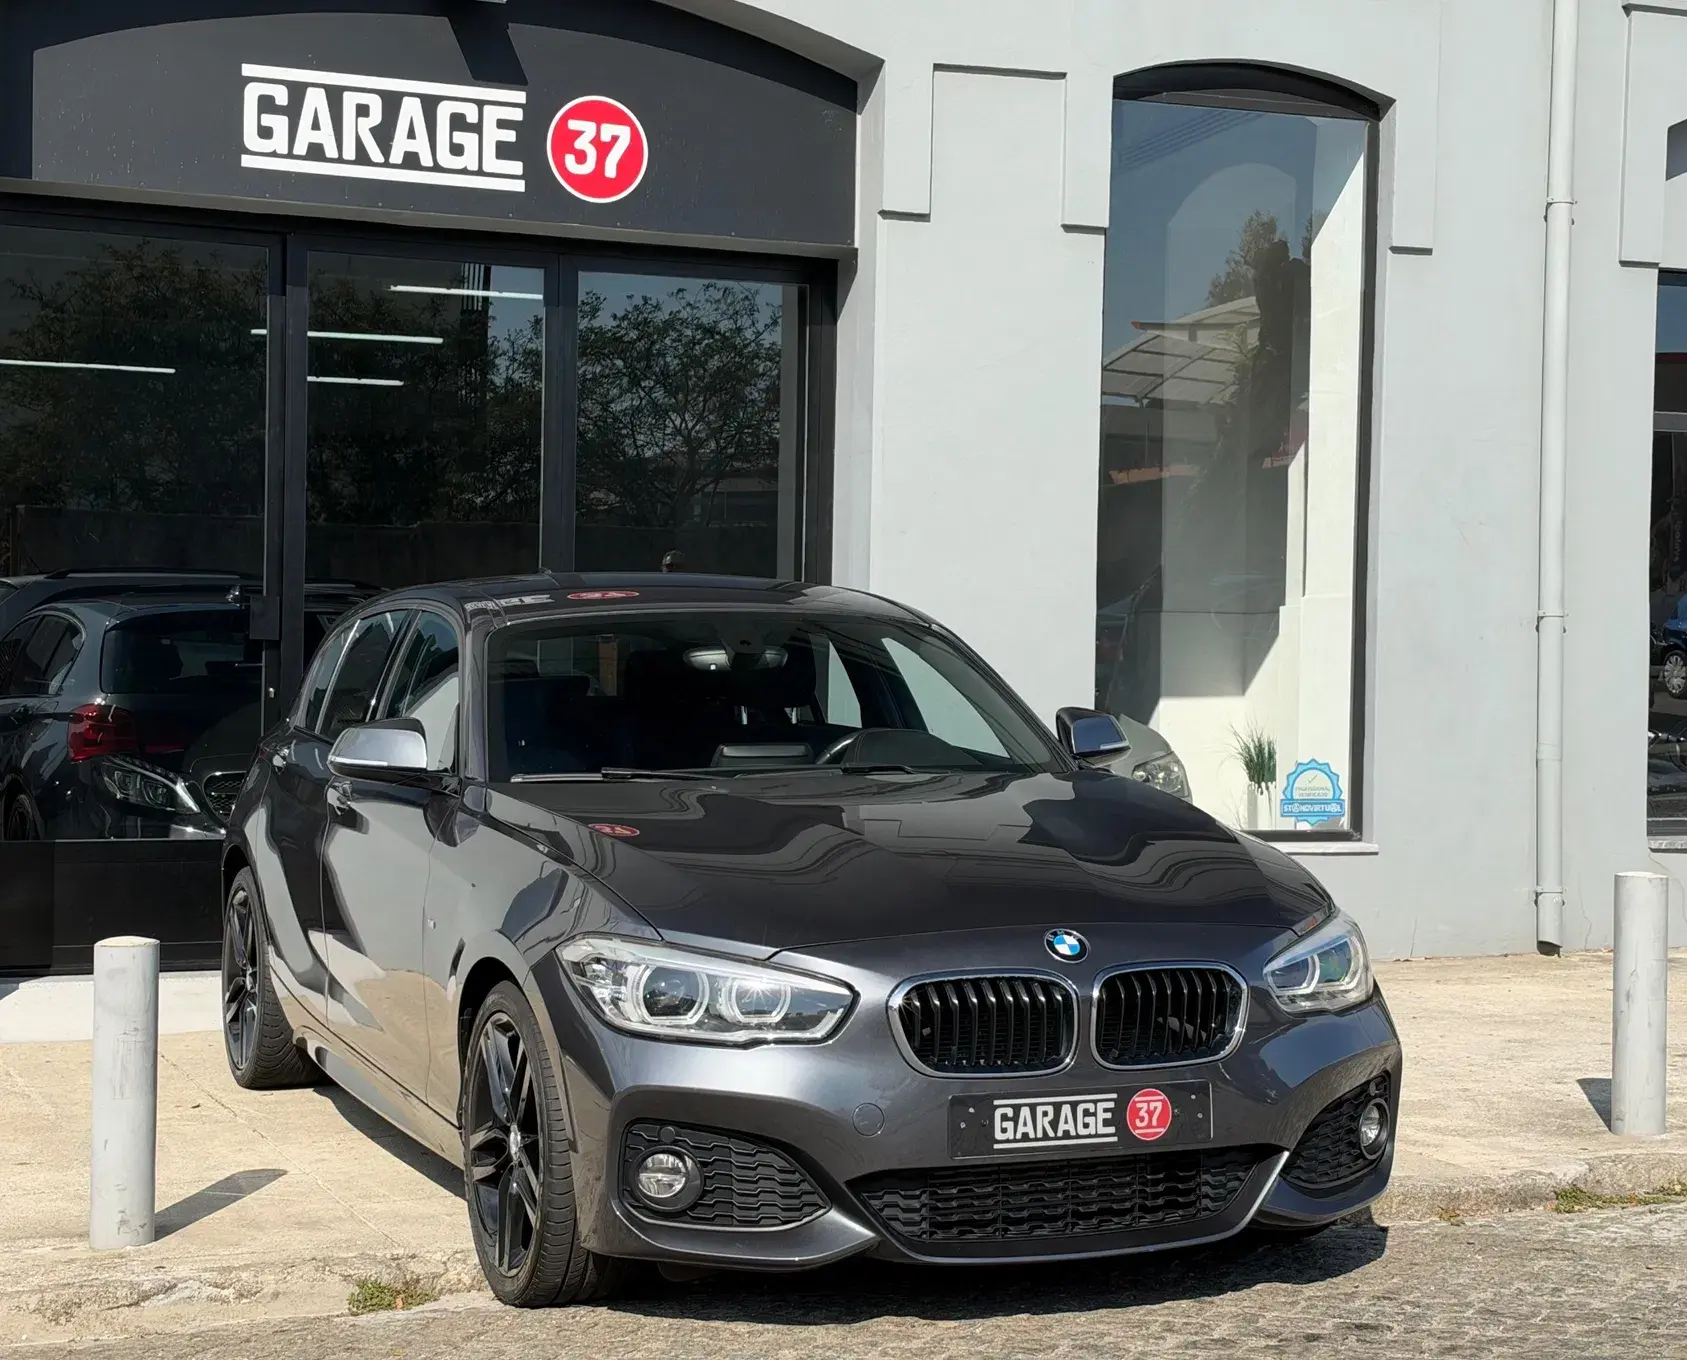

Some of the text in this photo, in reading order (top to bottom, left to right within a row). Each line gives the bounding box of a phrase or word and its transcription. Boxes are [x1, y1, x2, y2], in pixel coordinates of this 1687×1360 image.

[243, 81, 632, 179] GARAGE 37
[994, 1101, 1163, 1141] GARAGE 37
